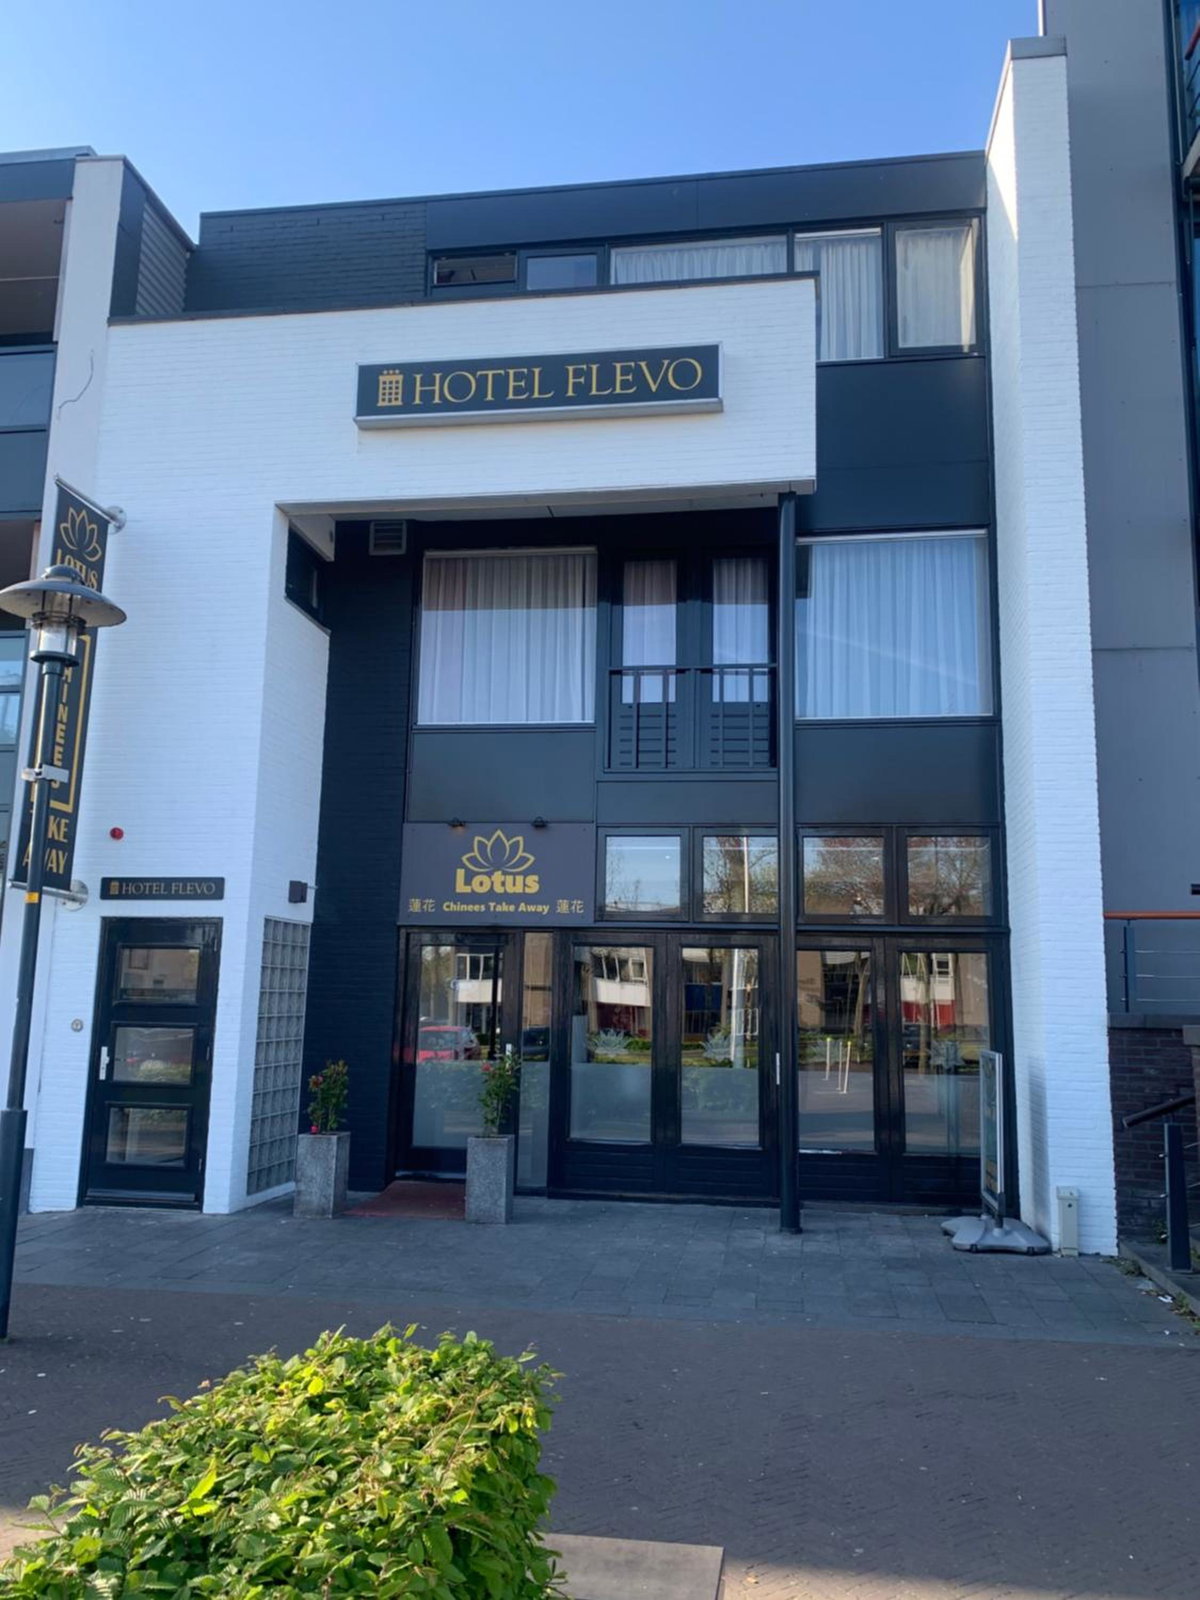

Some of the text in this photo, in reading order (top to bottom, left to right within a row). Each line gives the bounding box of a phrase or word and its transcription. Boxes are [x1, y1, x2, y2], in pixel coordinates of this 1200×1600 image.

[412, 358, 703, 405] HOTEL FLEVO
[122, 881, 216, 895] HOTEL FLEVO
[455, 868, 540, 894] Lotus
[442, 901, 550, 915] Chinees Take Away
